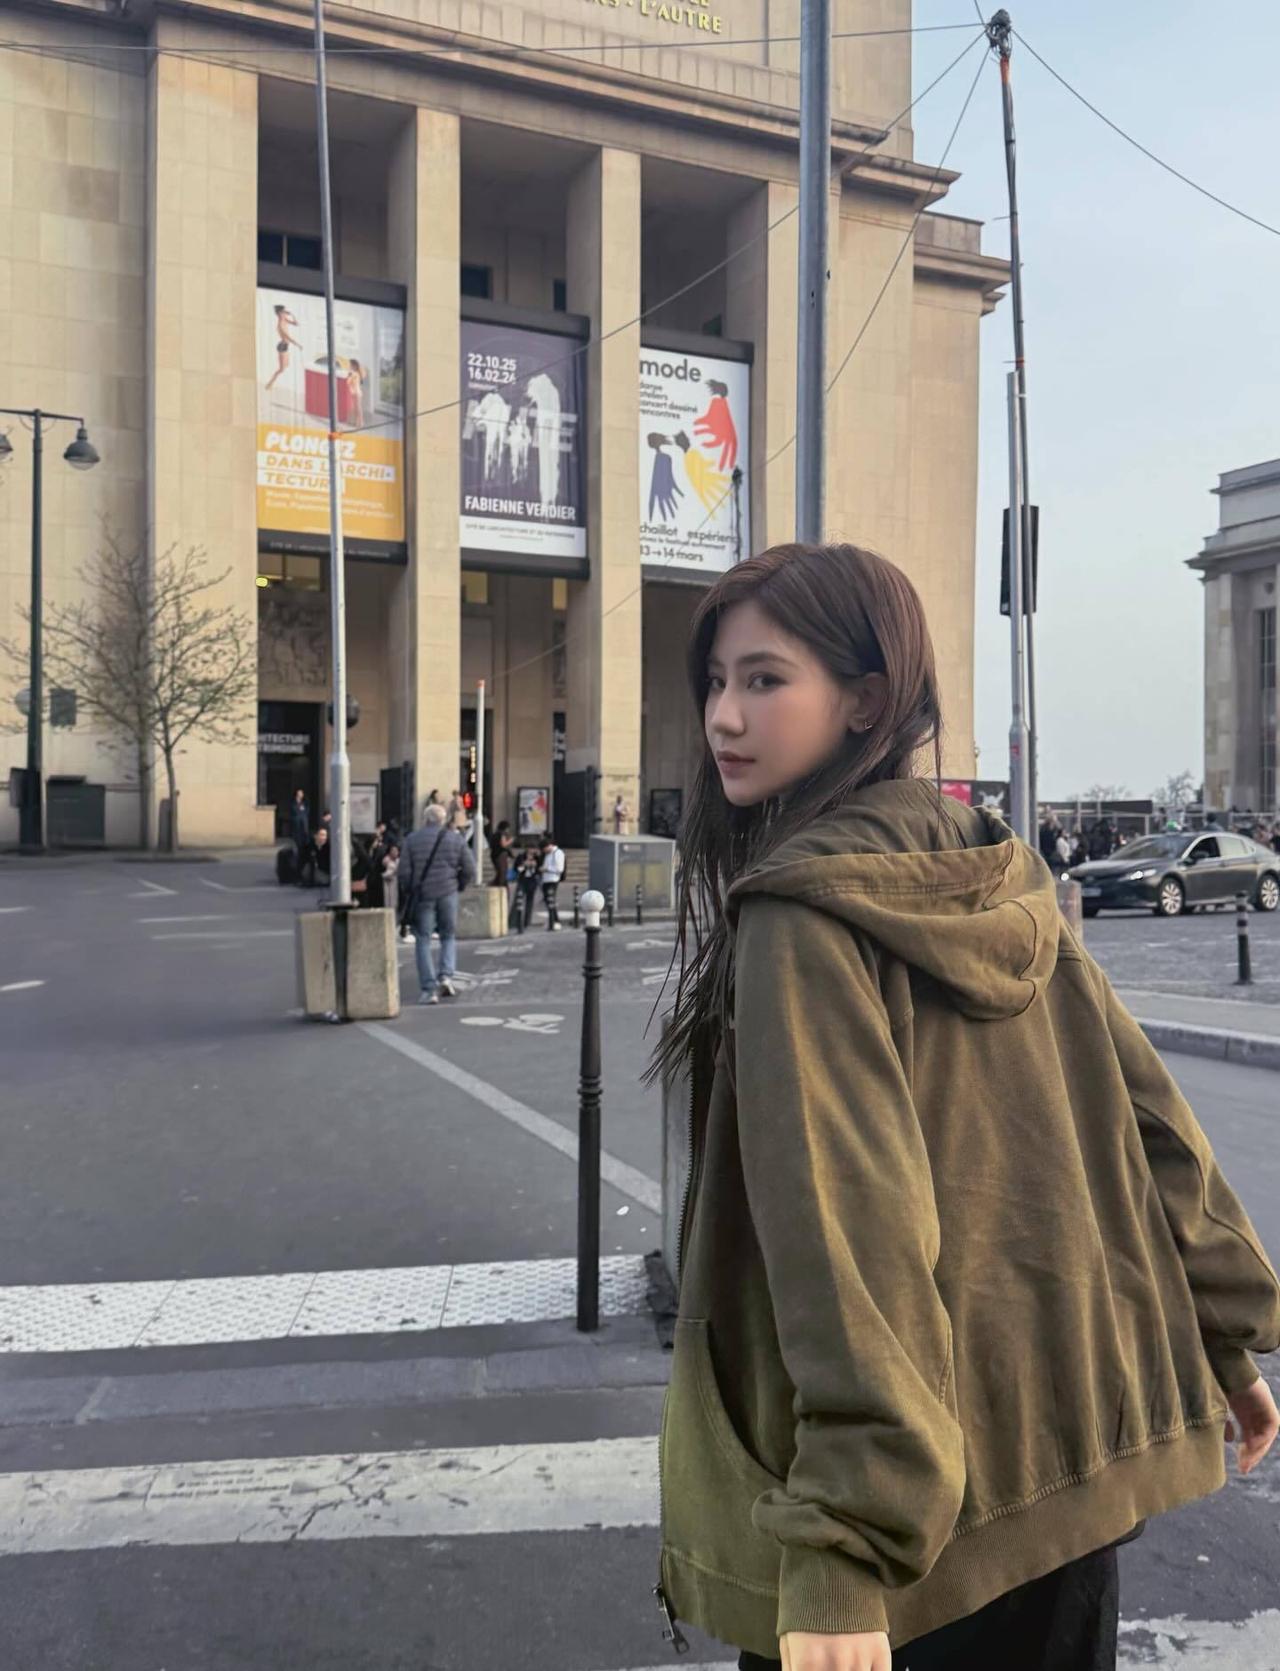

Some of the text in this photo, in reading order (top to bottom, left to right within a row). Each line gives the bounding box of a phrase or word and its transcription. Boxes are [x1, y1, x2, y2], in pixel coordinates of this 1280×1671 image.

[467, 353, 517, 371] 22.10.25
[639, 358, 702, 382] mode
[266, 455, 314, 471] DANS
[266, 471, 332, 489] TECTUR
[464, 495, 577, 521] FABIENNE VERDIER
[663, 547, 675, 559] 14
[676, 551, 704, 562] mars
